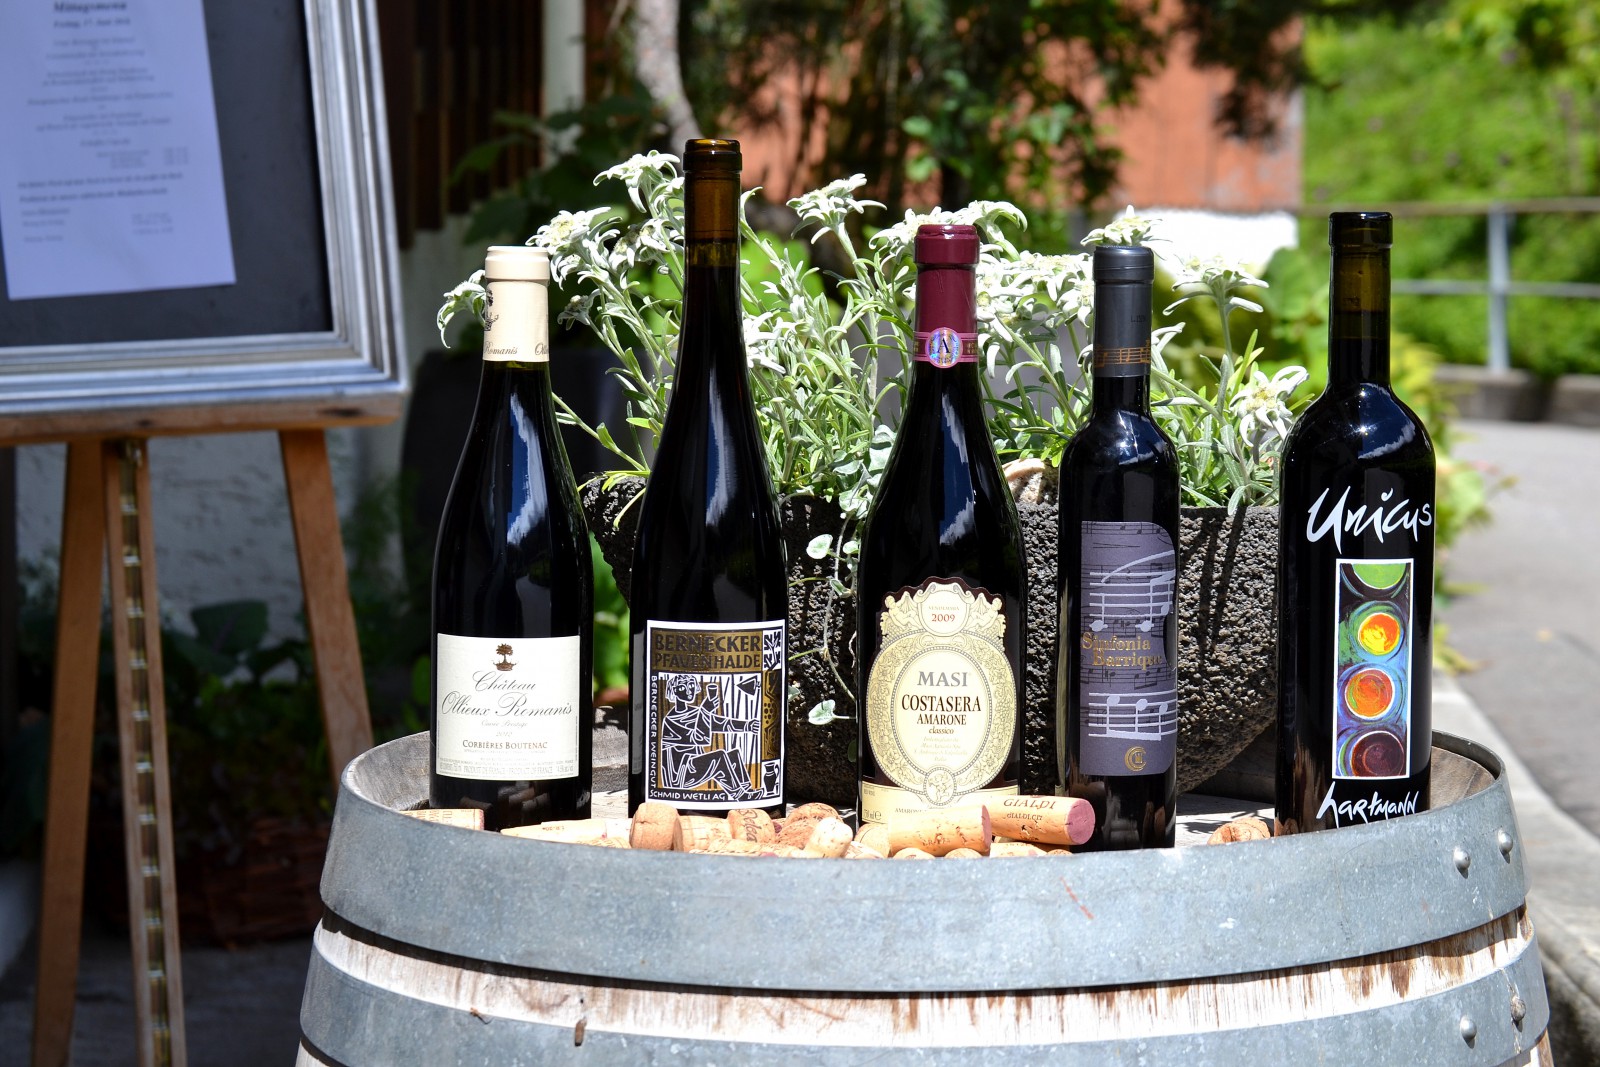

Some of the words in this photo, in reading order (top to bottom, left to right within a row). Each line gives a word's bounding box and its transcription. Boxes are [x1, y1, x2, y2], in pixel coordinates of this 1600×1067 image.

[931, 613, 956, 623] 2009
[655, 634, 760, 652] BERNECKER
[1082, 631, 1151, 650] Sinfonia
[655, 653, 761, 669] PFAUENHALDE
[1092, 647, 1163, 671] Barrique
[472, 670, 537, 692] Château
[917, 671, 969, 687] MASI
[441, 690, 492, 715] Ollieux
[495, 691, 573, 717] Romanis
[901, 693, 982, 712] COSTASERA
[916, 713, 967, 726] AMARONE
[928, 726, 955, 735] classico
[462, 739, 504, 750] CORBIÈRES
[505, 741, 548, 750] BOUTENAC
[649, 741, 657, 788] WEINGUT
[649, 789, 681, 800] SCHMID
[712, 793, 726, 801] AG
[1003, 799, 1057, 810] GIALDI
